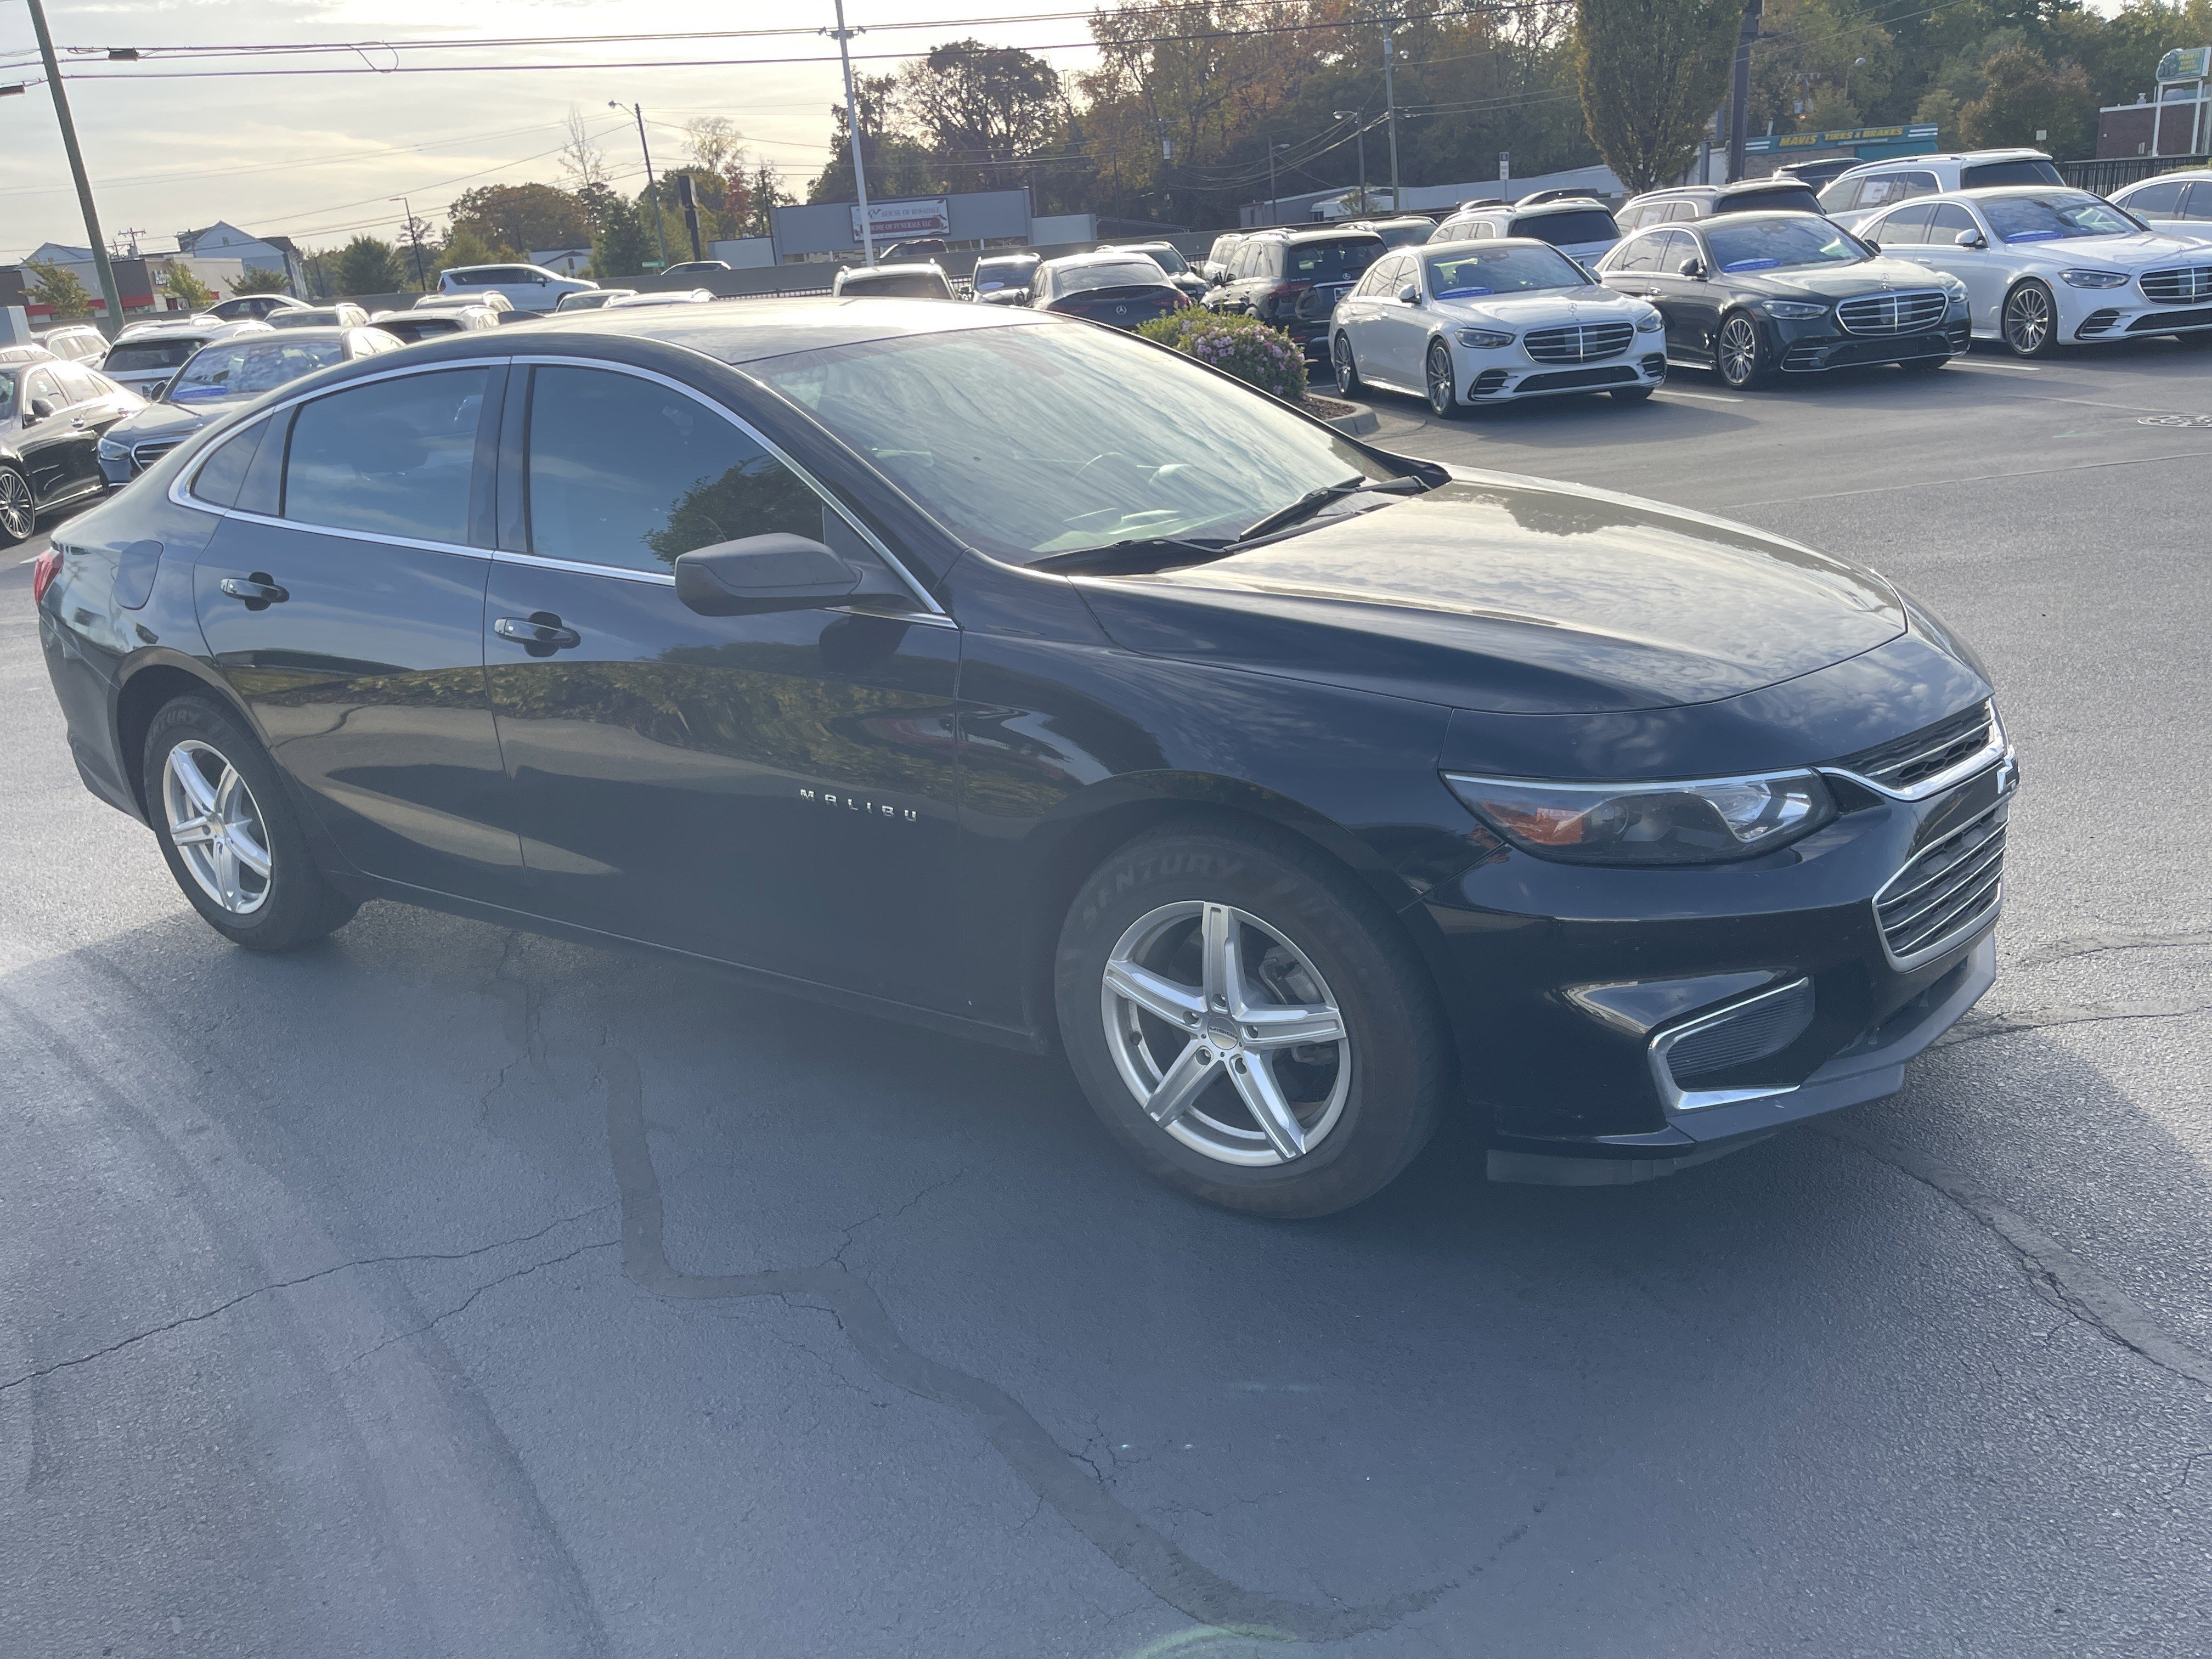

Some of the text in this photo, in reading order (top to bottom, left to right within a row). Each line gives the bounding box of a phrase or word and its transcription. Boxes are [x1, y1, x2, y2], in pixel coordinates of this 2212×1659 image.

[1779, 134, 1818, 146] MAVIS
[1824, 132, 1853, 141] TIRES
[1863, 128, 1903, 138] BRAKES
[800, 789, 917, 822] MALIBU
[1209, 1026, 1238, 1040] VISION
